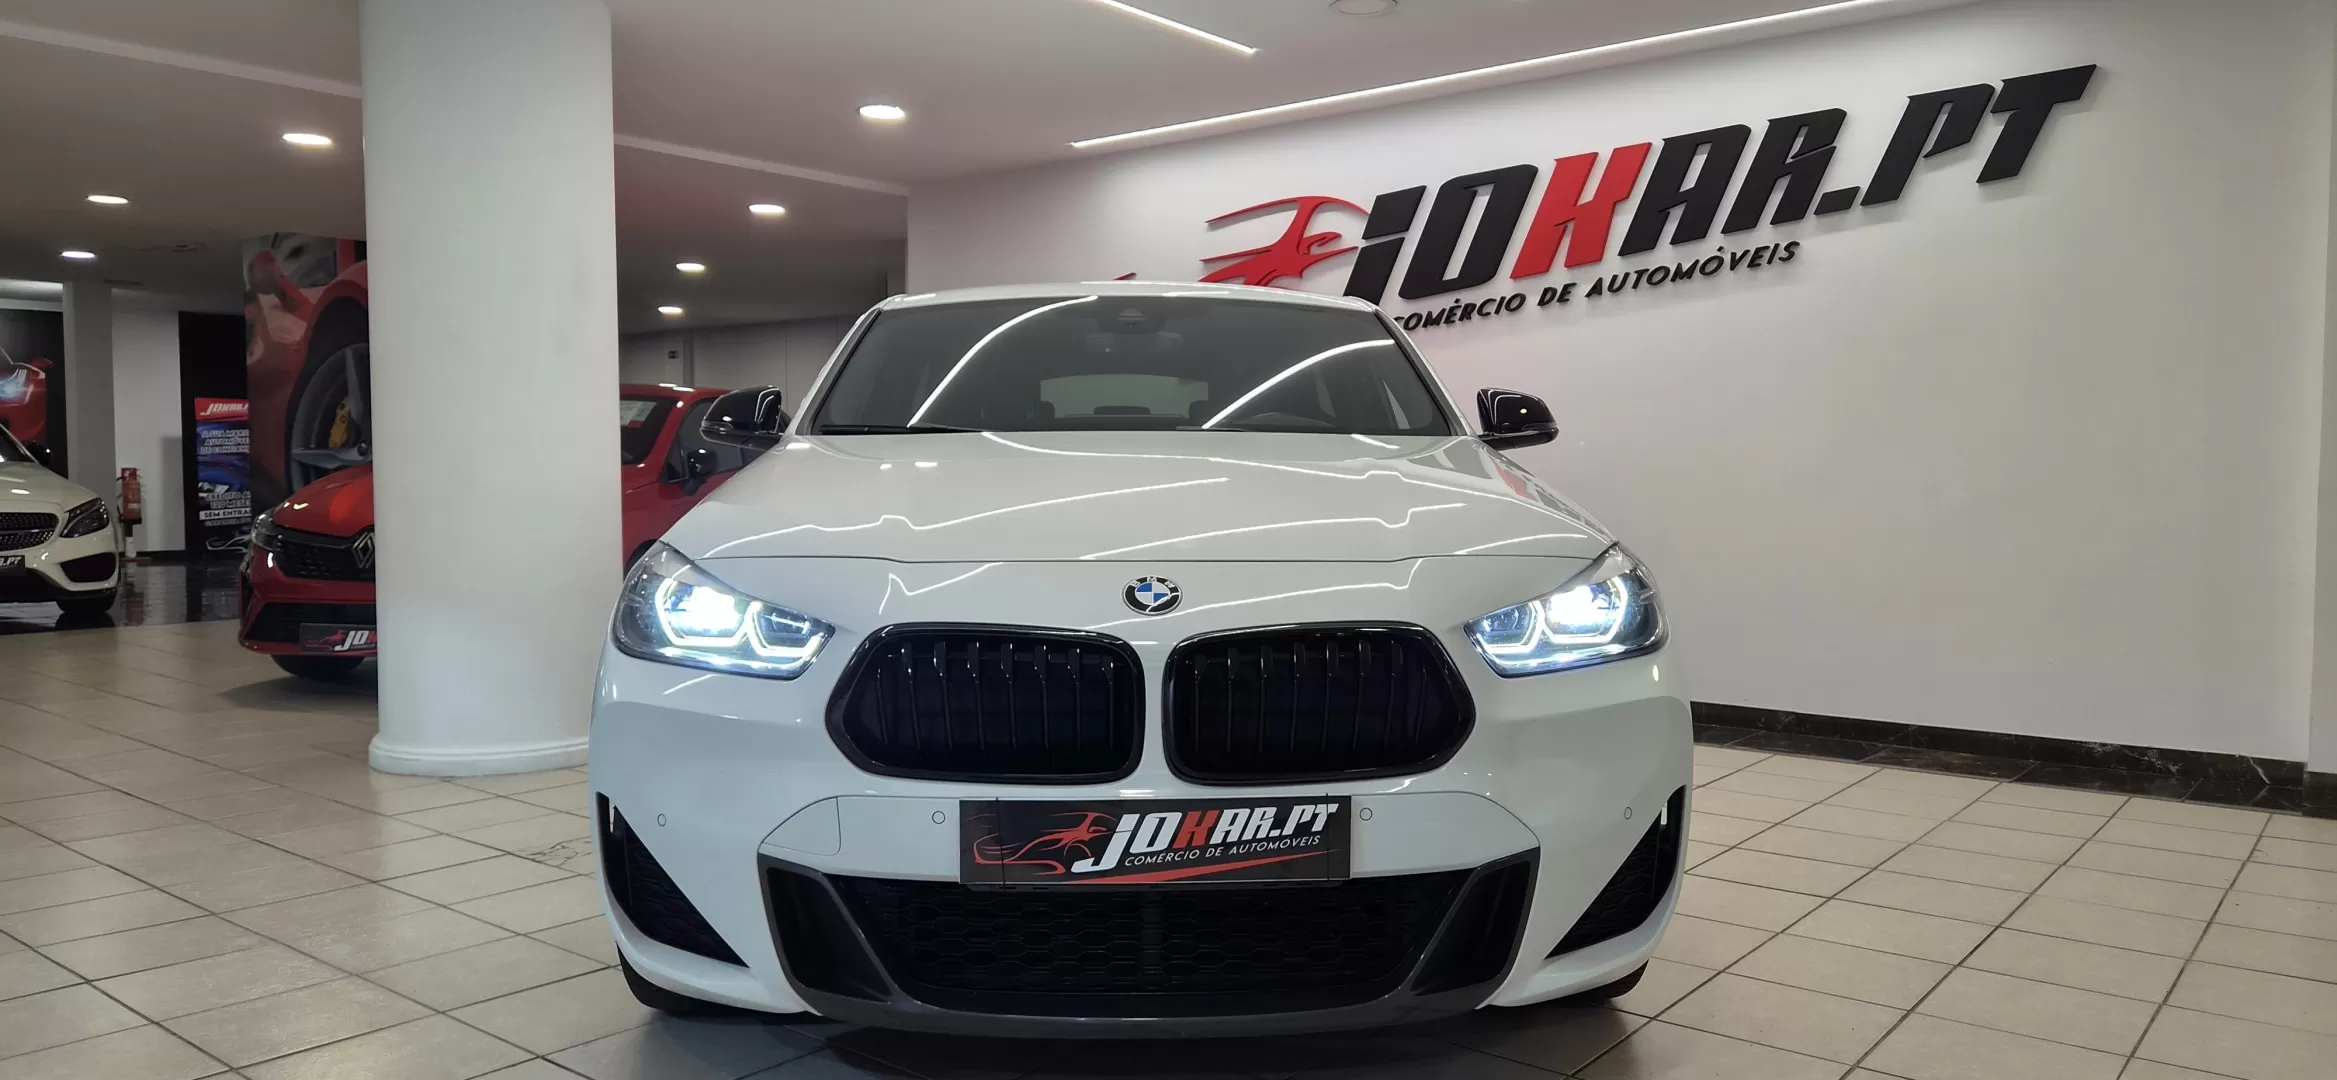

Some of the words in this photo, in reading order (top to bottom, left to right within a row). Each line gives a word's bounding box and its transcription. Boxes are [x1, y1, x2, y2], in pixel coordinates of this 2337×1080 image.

[1342, 64, 2097, 306] JOKAR.PT
[1537, 282, 1578, 307] DE
[1584, 240, 1801, 298] AUTOMÓVEIS
[222, 509, 251, 517] ENTRA
[1070, 803, 1340, 873] JOKAR.PT
[1124, 849, 1200, 866] COMÉRCIO
[1205, 846, 1225, 858] DE
[1229, 835, 1321, 855] AUTOMÓVEIS
